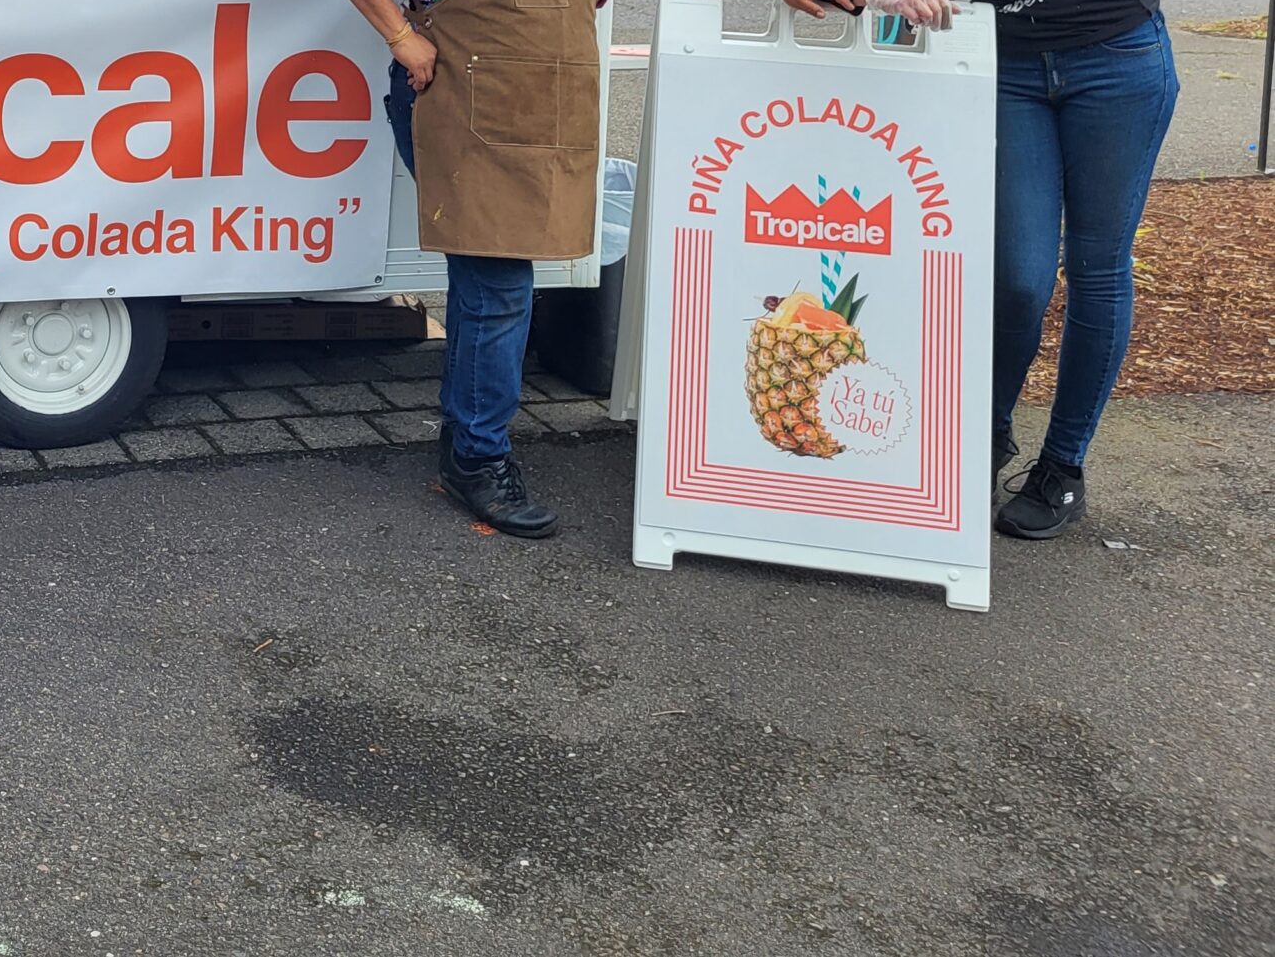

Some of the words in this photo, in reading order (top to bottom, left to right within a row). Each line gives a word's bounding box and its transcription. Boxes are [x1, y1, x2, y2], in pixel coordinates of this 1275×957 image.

[688, 136, 745, 215] PIÑA
[740, 96, 899, 151] COLADA
[897, 145, 953, 237] KING
[7, 210, 197, 257] Colada
[750, 210, 885, 245] Tropicale
[830, 400, 891, 439] Sabe!
[872, 388, 895, 414] tú
